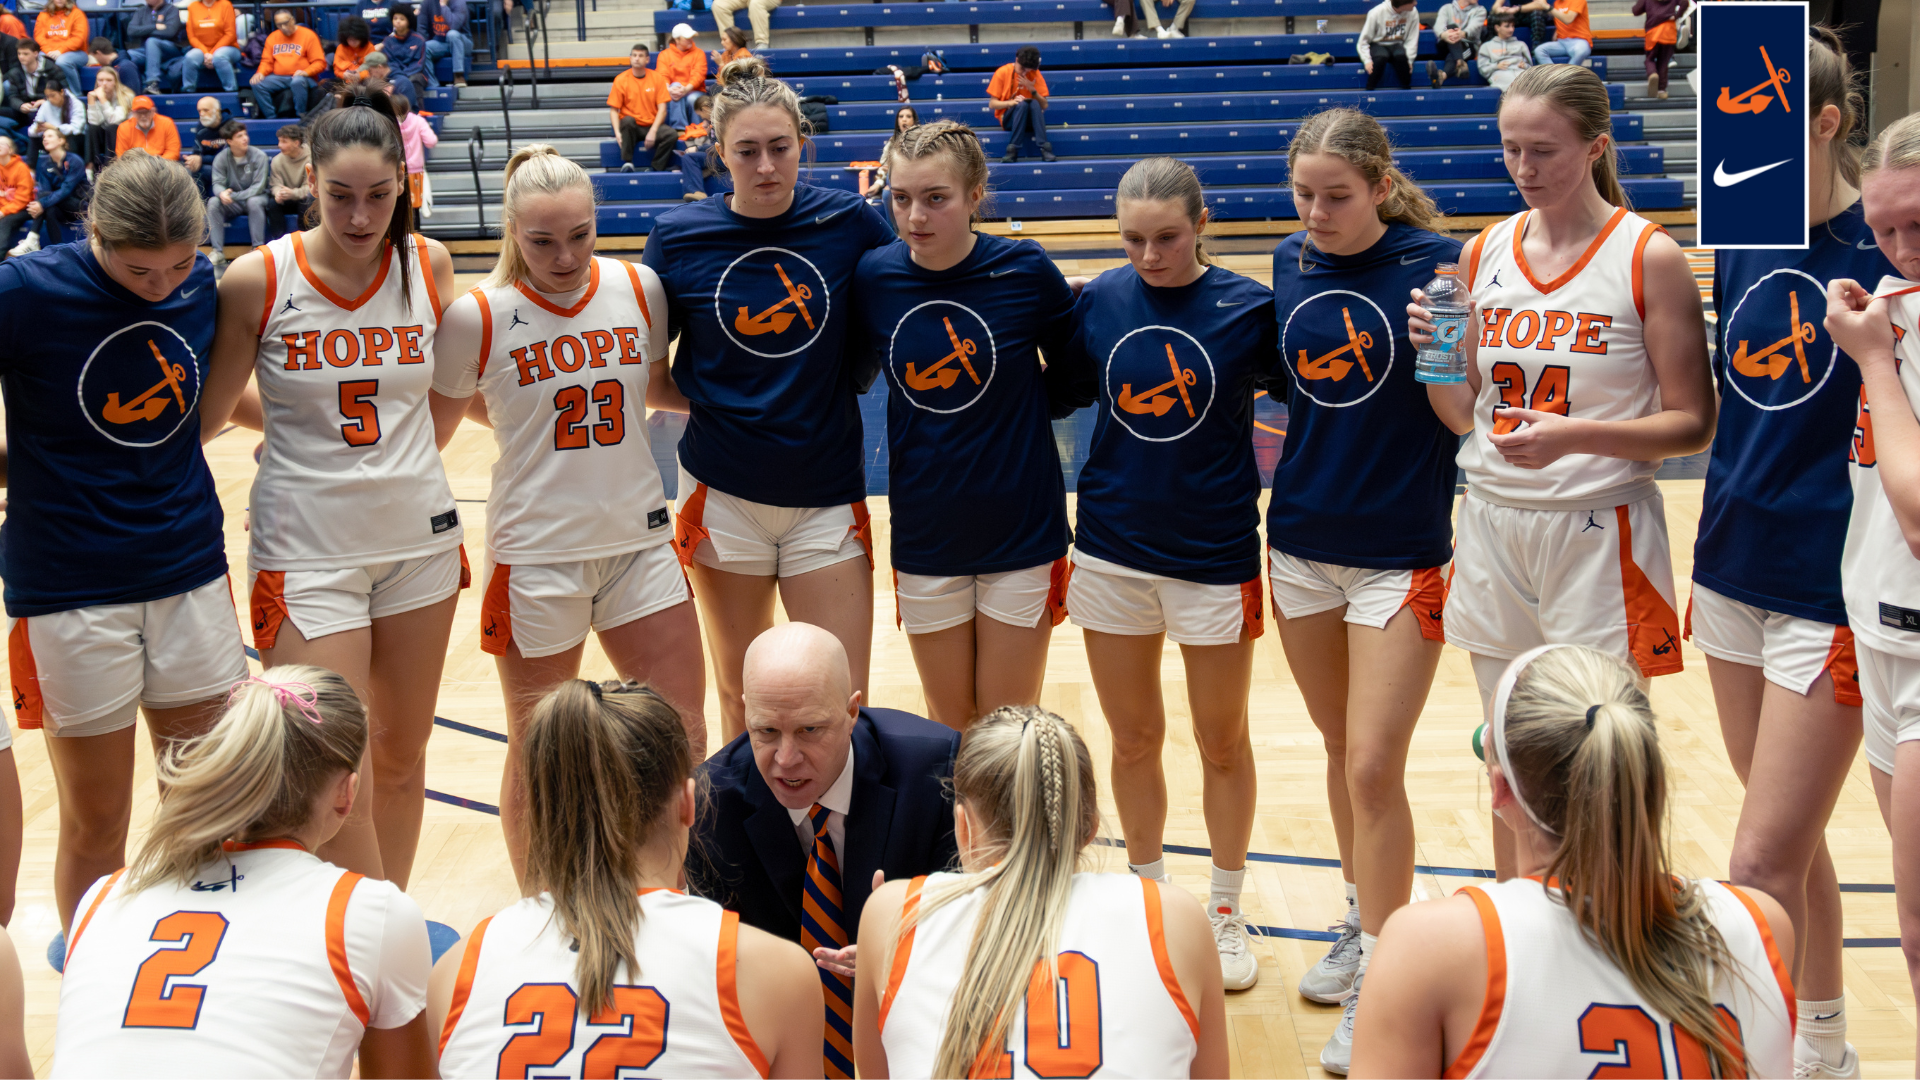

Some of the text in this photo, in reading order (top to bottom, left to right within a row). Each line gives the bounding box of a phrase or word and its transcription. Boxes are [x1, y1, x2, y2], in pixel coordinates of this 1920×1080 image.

[273, 43, 302, 56] HOPE
[281, 325, 425, 371] HOPE
[509, 327, 642, 387] HOPE
[1426, 351, 1456, 361] FROST
[1437, 321, 1459, 343] G
[1479, 308, 1613, 355] HOPE
[338, 379, 382, 447] 5
[553, 378, 625, 451] 23
[1491, 361, 1571, 432] 34
[1905, 614, 1918, 626] XL
[121, 910, 230, 1031] 2
[496, 982, 670, 1080] 22
